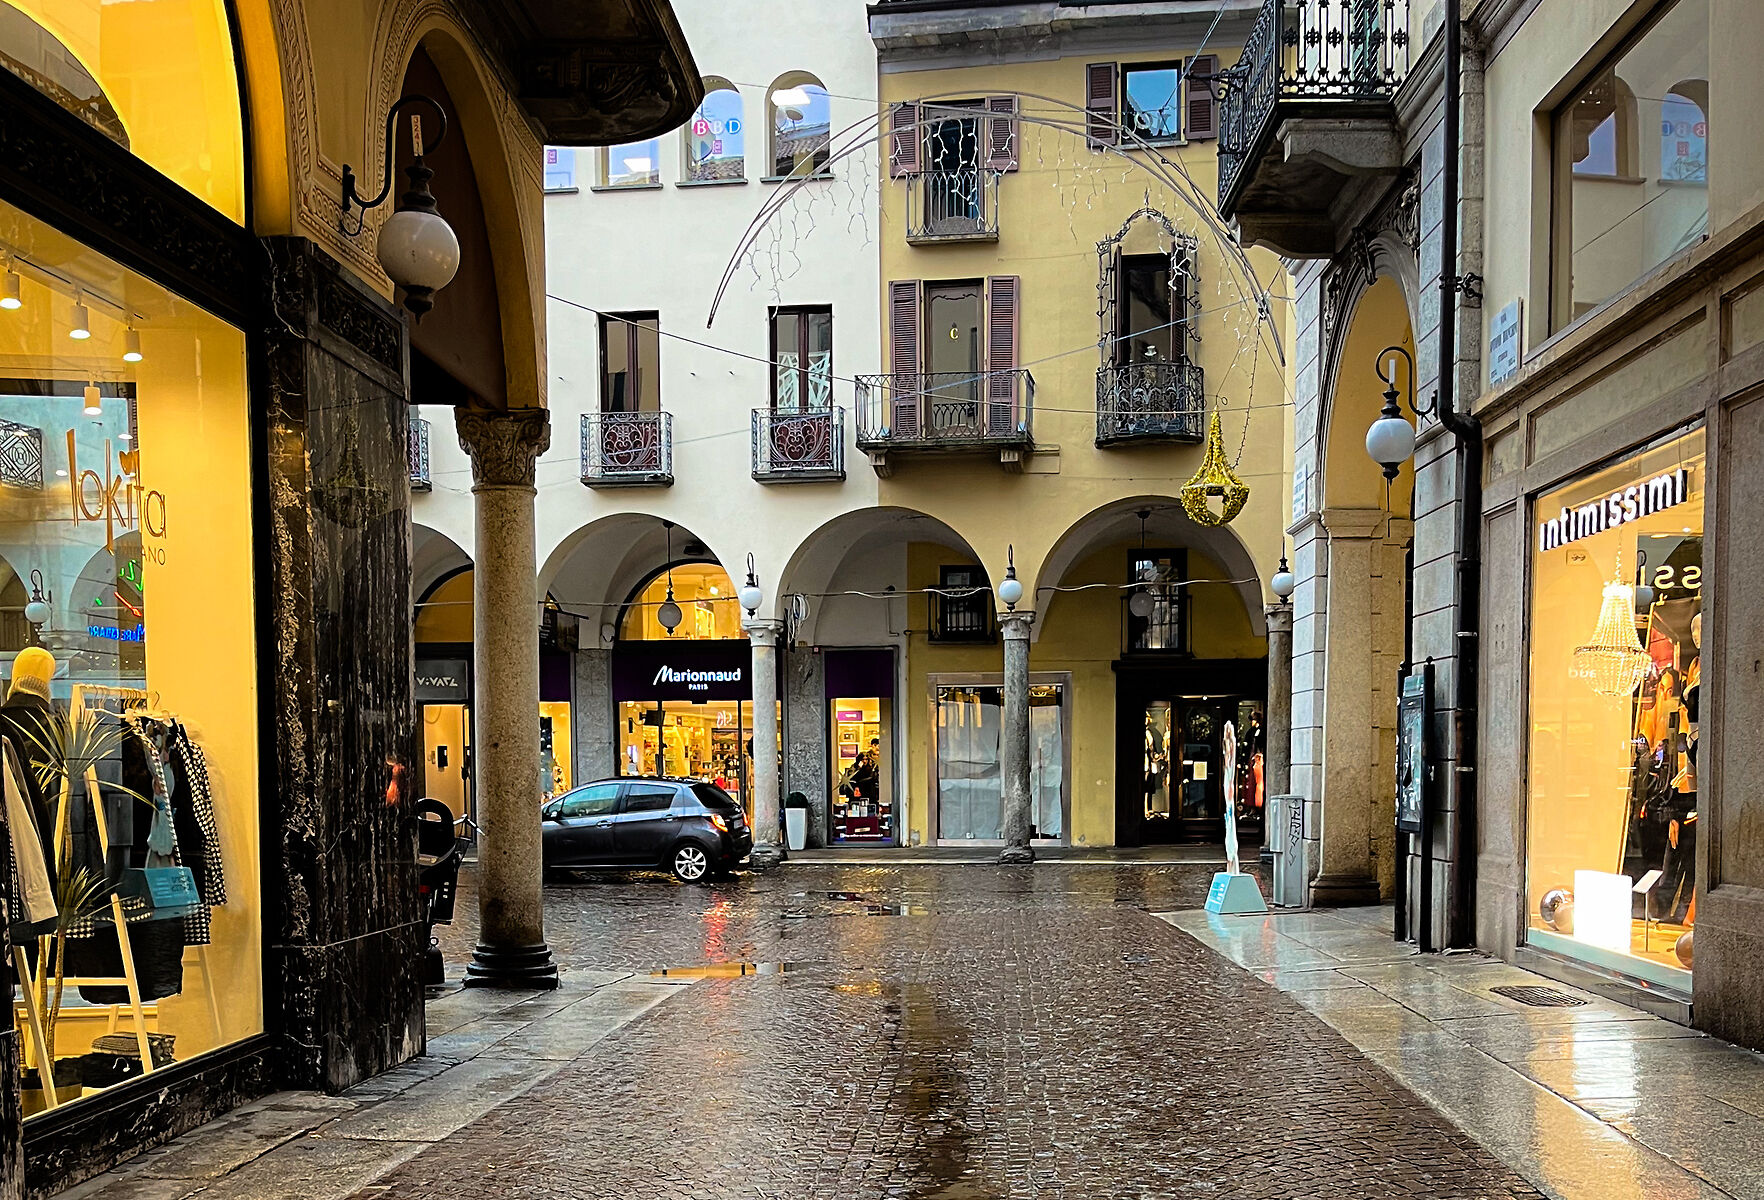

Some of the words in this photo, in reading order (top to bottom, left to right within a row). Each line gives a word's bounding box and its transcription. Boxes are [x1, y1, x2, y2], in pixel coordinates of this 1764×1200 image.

[66, 428, 167, 556] lokita
[1538, 467, 1686, 553] intimissimi
[652, 664, 742, 686] Marionnaud
[688, 683, 709, 691] PARIS
